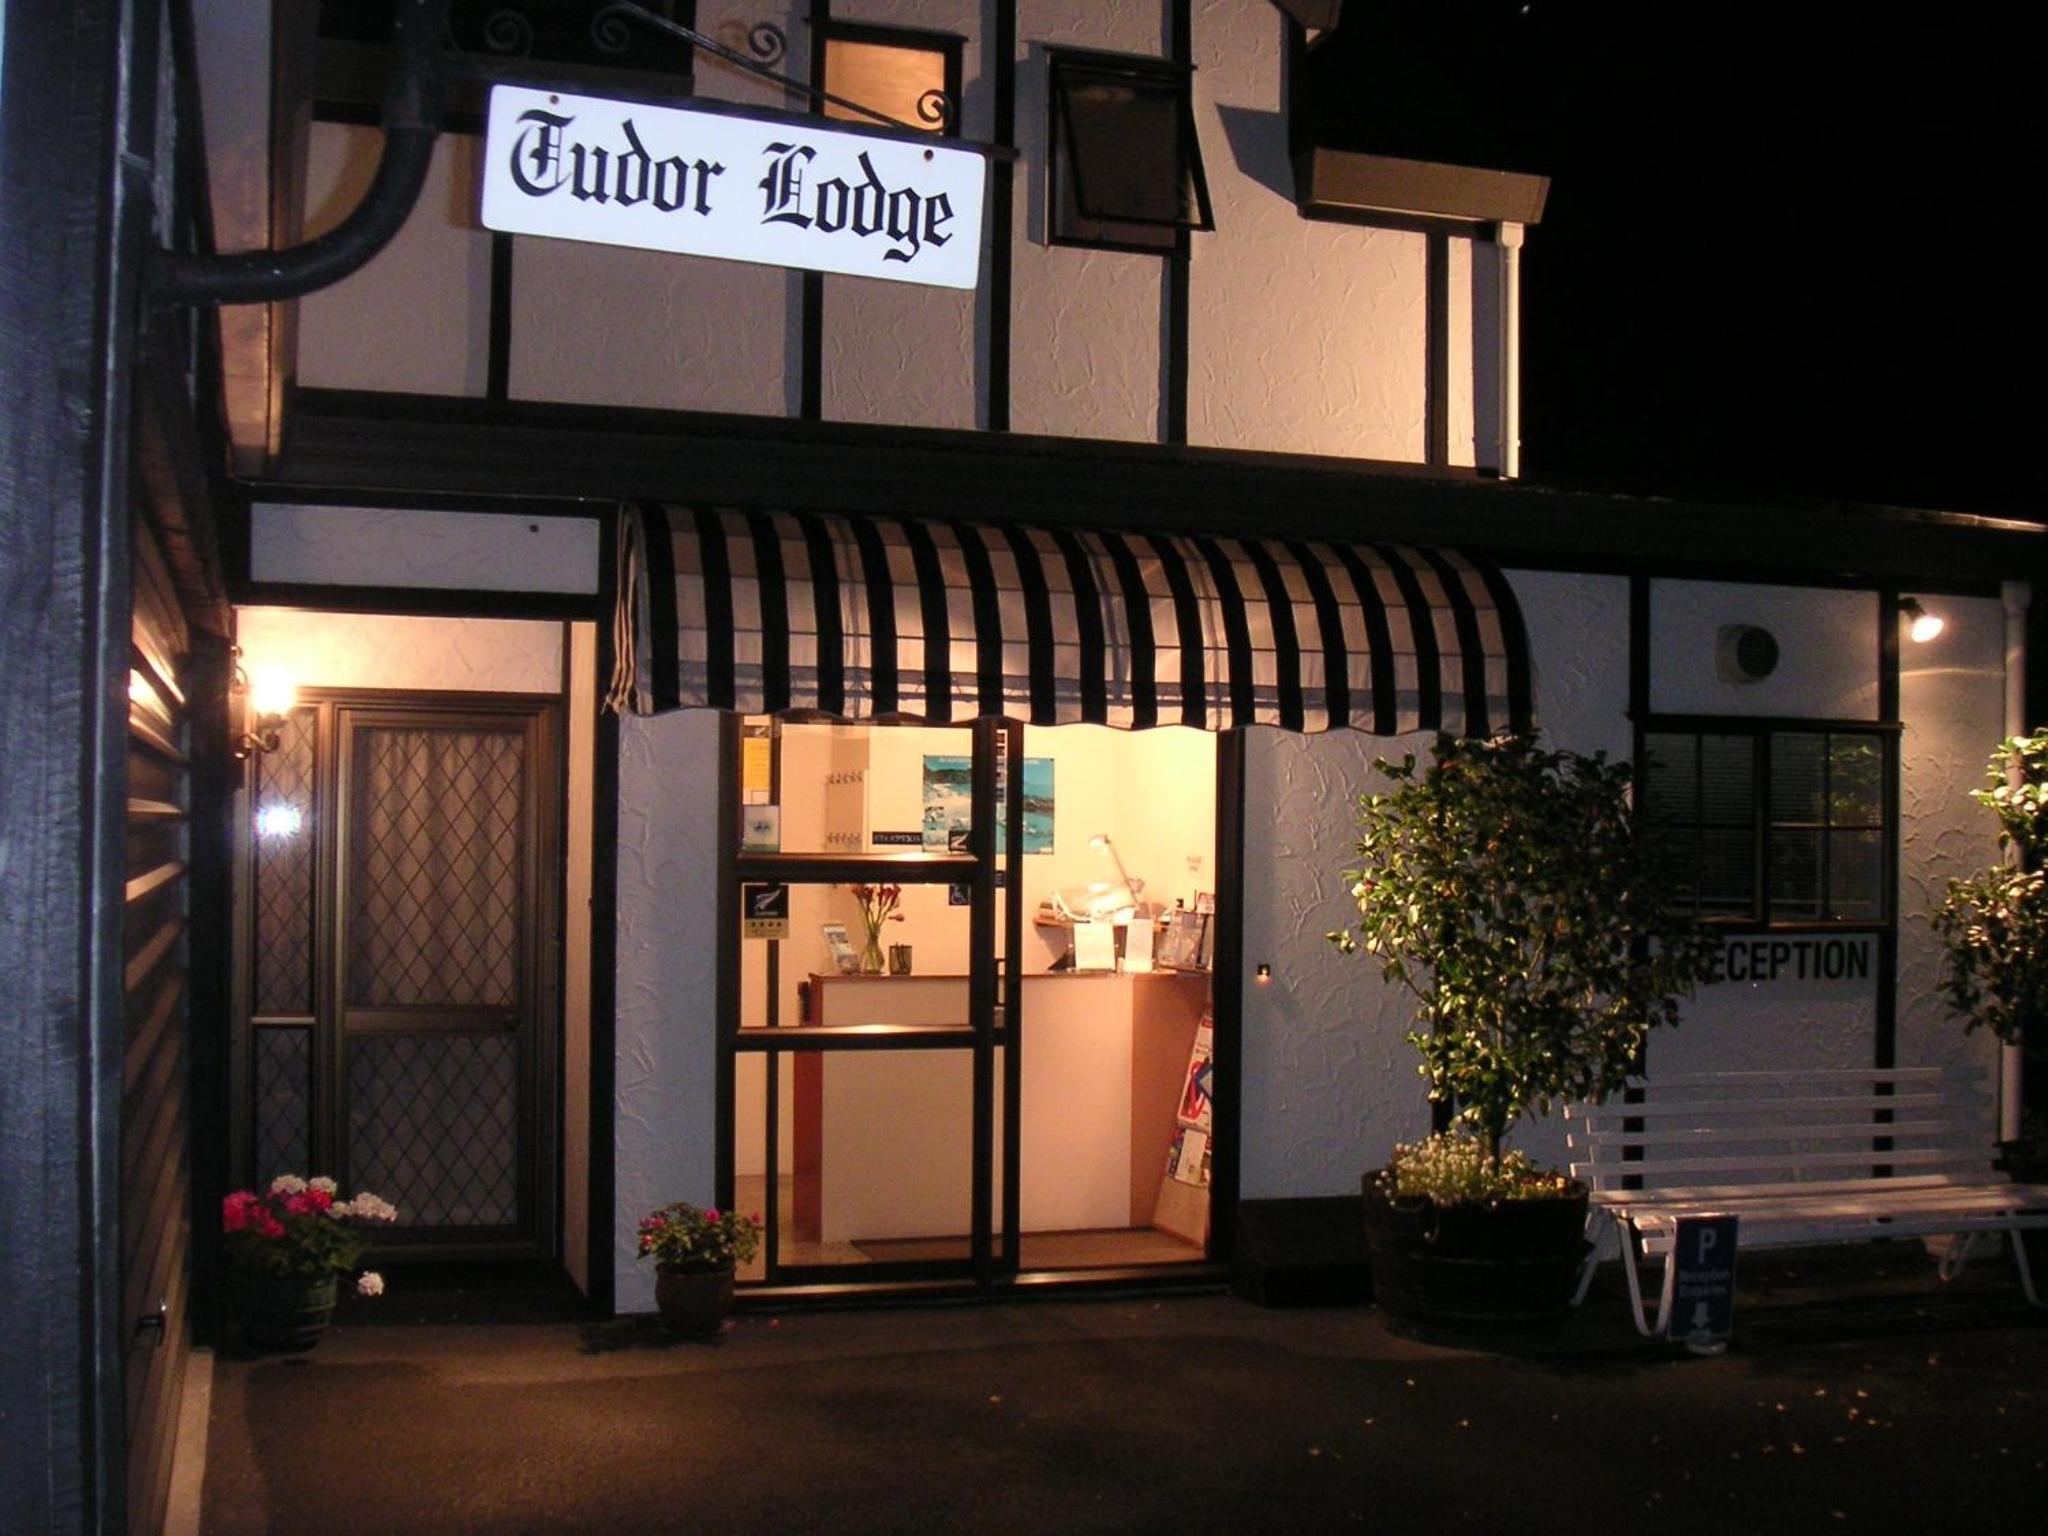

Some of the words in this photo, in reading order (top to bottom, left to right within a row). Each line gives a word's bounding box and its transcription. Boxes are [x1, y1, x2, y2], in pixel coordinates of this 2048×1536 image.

[510, 110, 725, 215] Tudor
[759, 143, 955, 262] Lodge
[1687, 940, 1868, 981] ECEPTION
[1698, 1228, 1717, 1264] P
